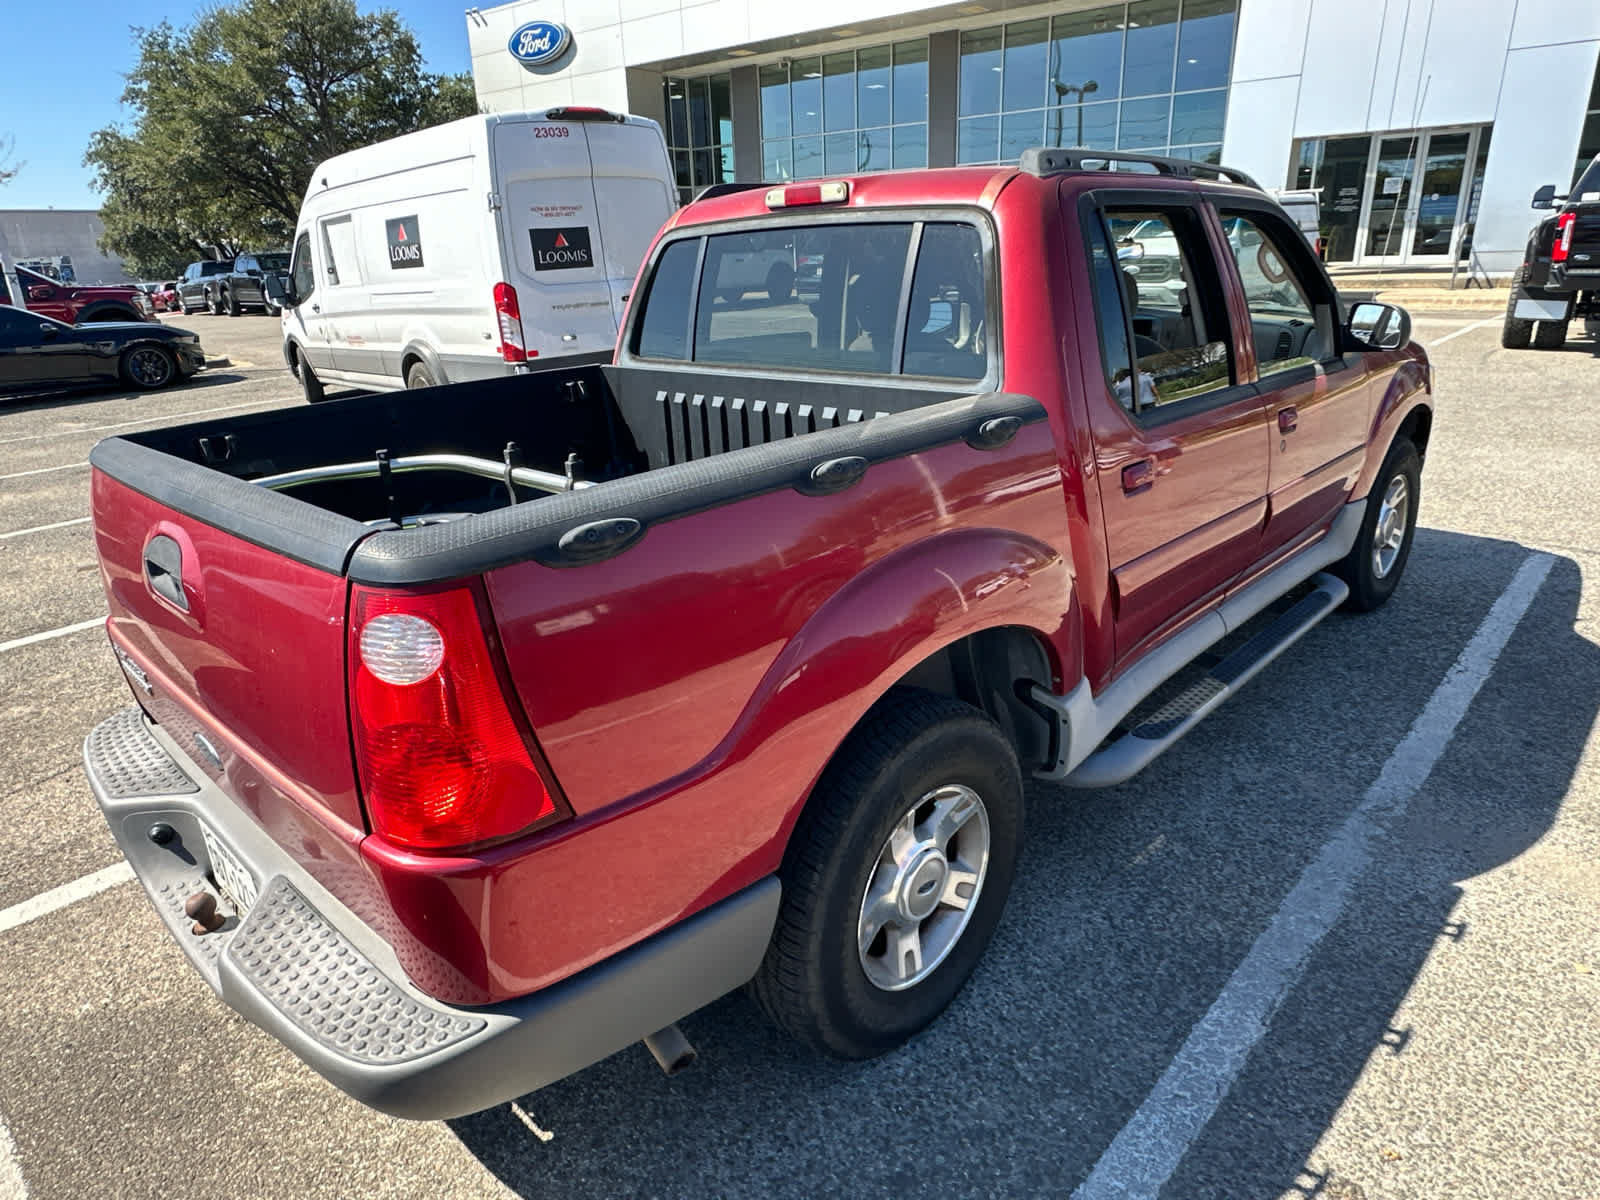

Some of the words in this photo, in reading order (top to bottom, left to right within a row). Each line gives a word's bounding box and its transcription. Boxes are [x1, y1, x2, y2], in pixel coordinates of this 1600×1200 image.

[518, 28, 551, 56] Ford
[534, 127, 569, 138] 23039
[390, 244, 420, 261] LOOMIS
[538, 249, 588, 264] LOOMIS
